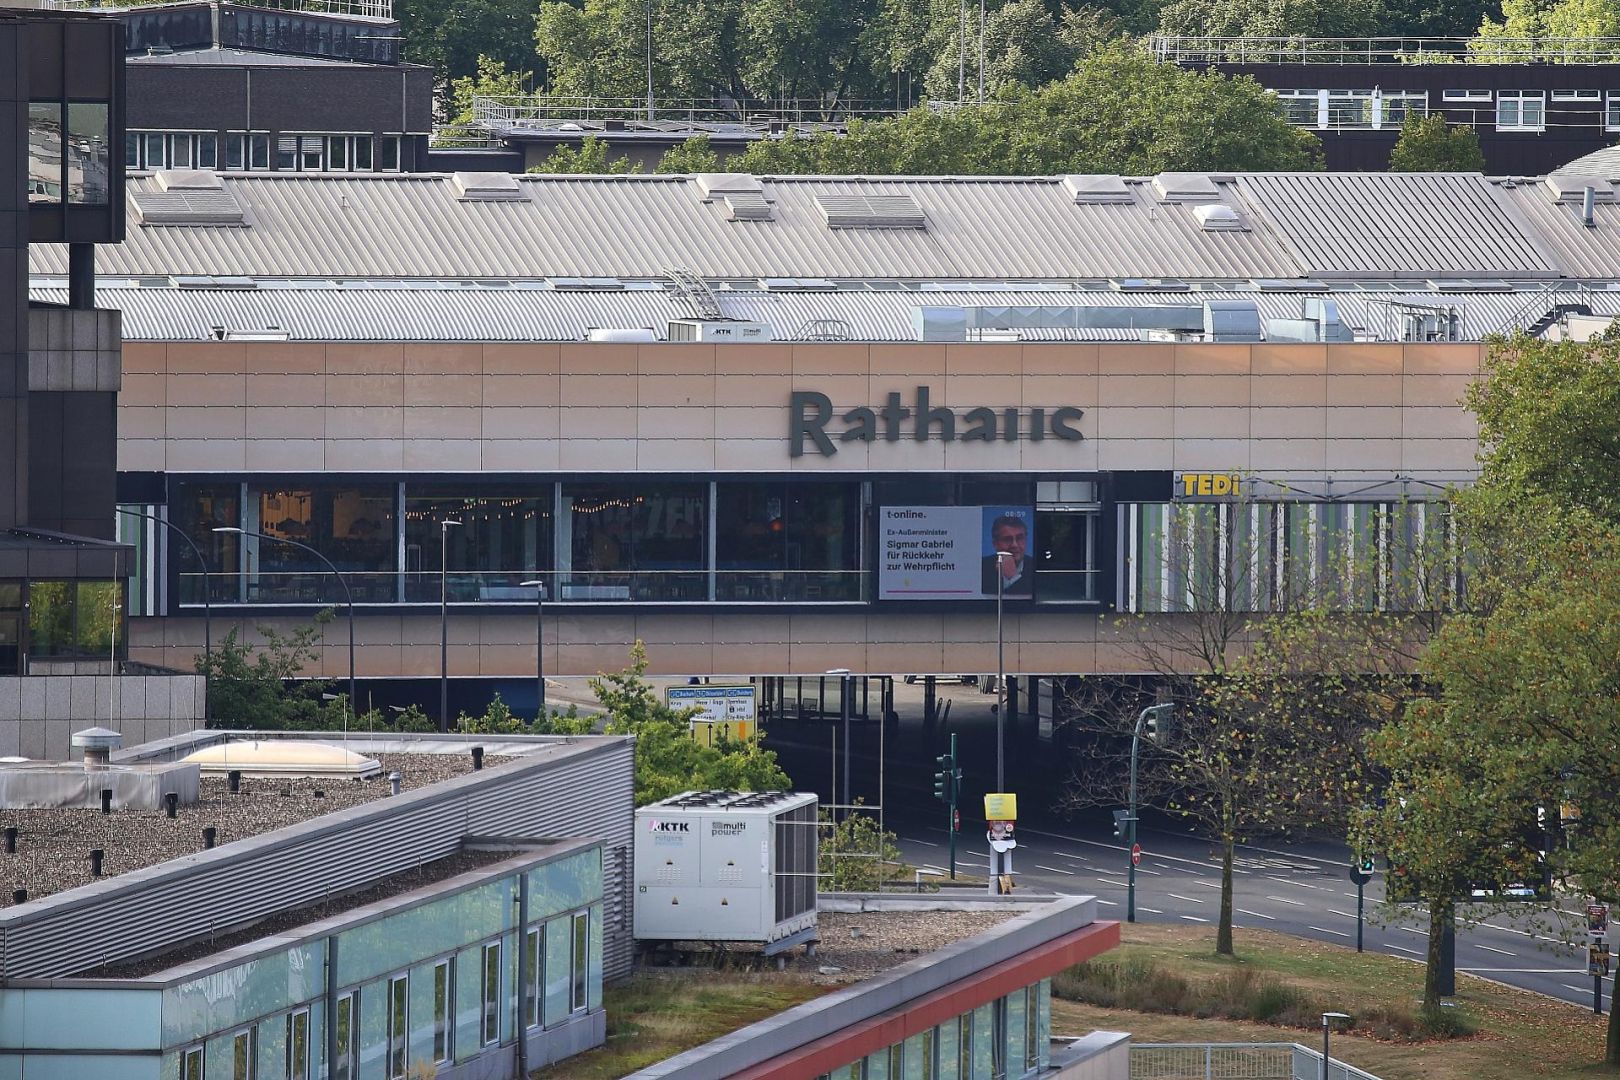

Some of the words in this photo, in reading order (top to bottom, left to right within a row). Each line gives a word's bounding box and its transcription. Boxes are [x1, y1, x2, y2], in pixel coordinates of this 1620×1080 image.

[791, 386, 1085, 458] Rathaus
[1182, 474, 1240, 496] TEDi
[887, 540, 919, 550] Sigmar
[921, 540, 954, 549] Gabriel
[887, 551, 900, 560] für
[902, 551, 944, 560] Rückkehr
[887, 563, 901, 571] zur
[903, 562, 955, 572] Wehrpflicht
[660, 822, 689, 832] KTK
[723, 822, 746, 830] multi
[711, 829, 742, 837] power
